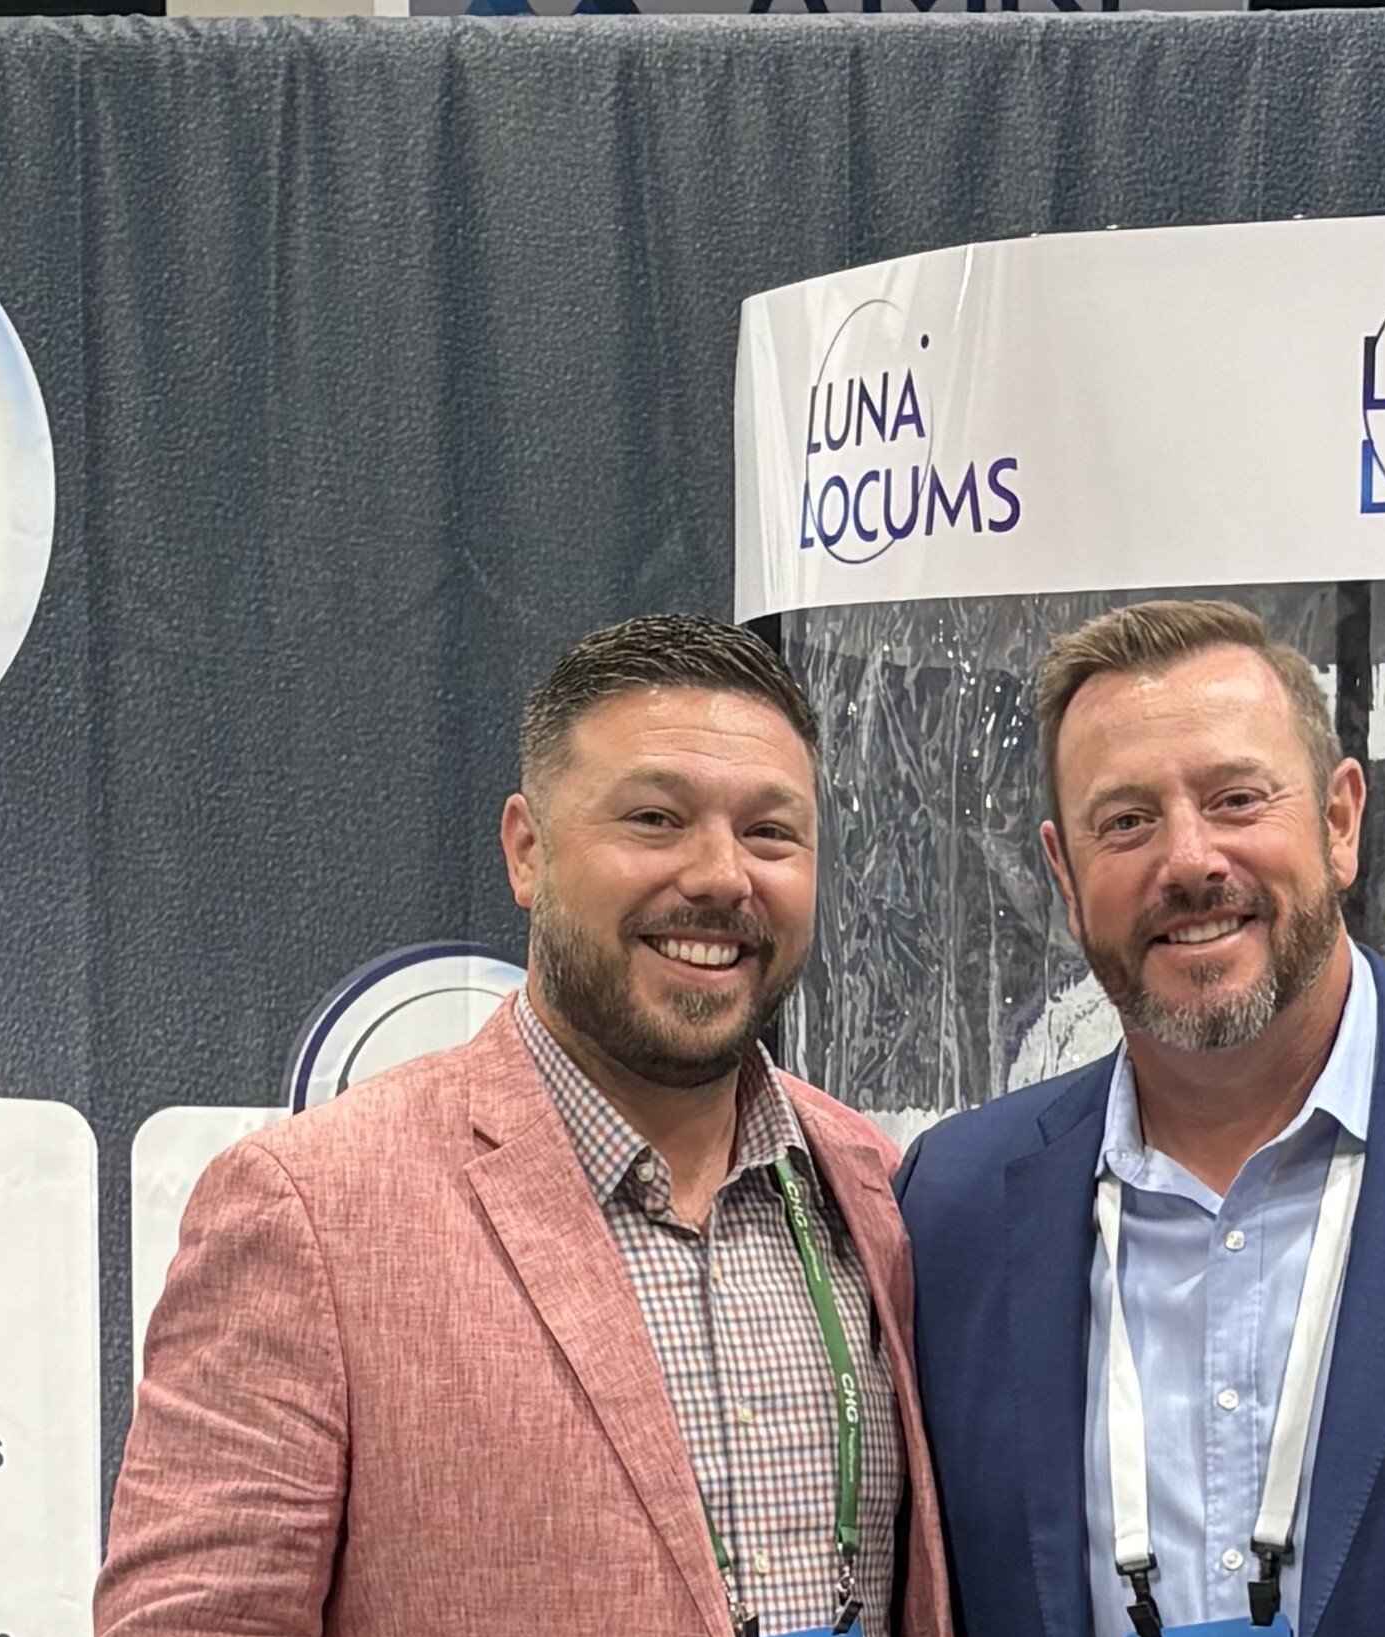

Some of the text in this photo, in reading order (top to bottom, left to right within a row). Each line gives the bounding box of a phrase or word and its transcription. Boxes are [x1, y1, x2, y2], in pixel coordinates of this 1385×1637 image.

[807, 367, 926, 453] LUNA
[799, 457, 1021, 550] LOCUMS
[784, 1180, 809, 1231] CHG
[840, 1373, 859, 1424] CHG
